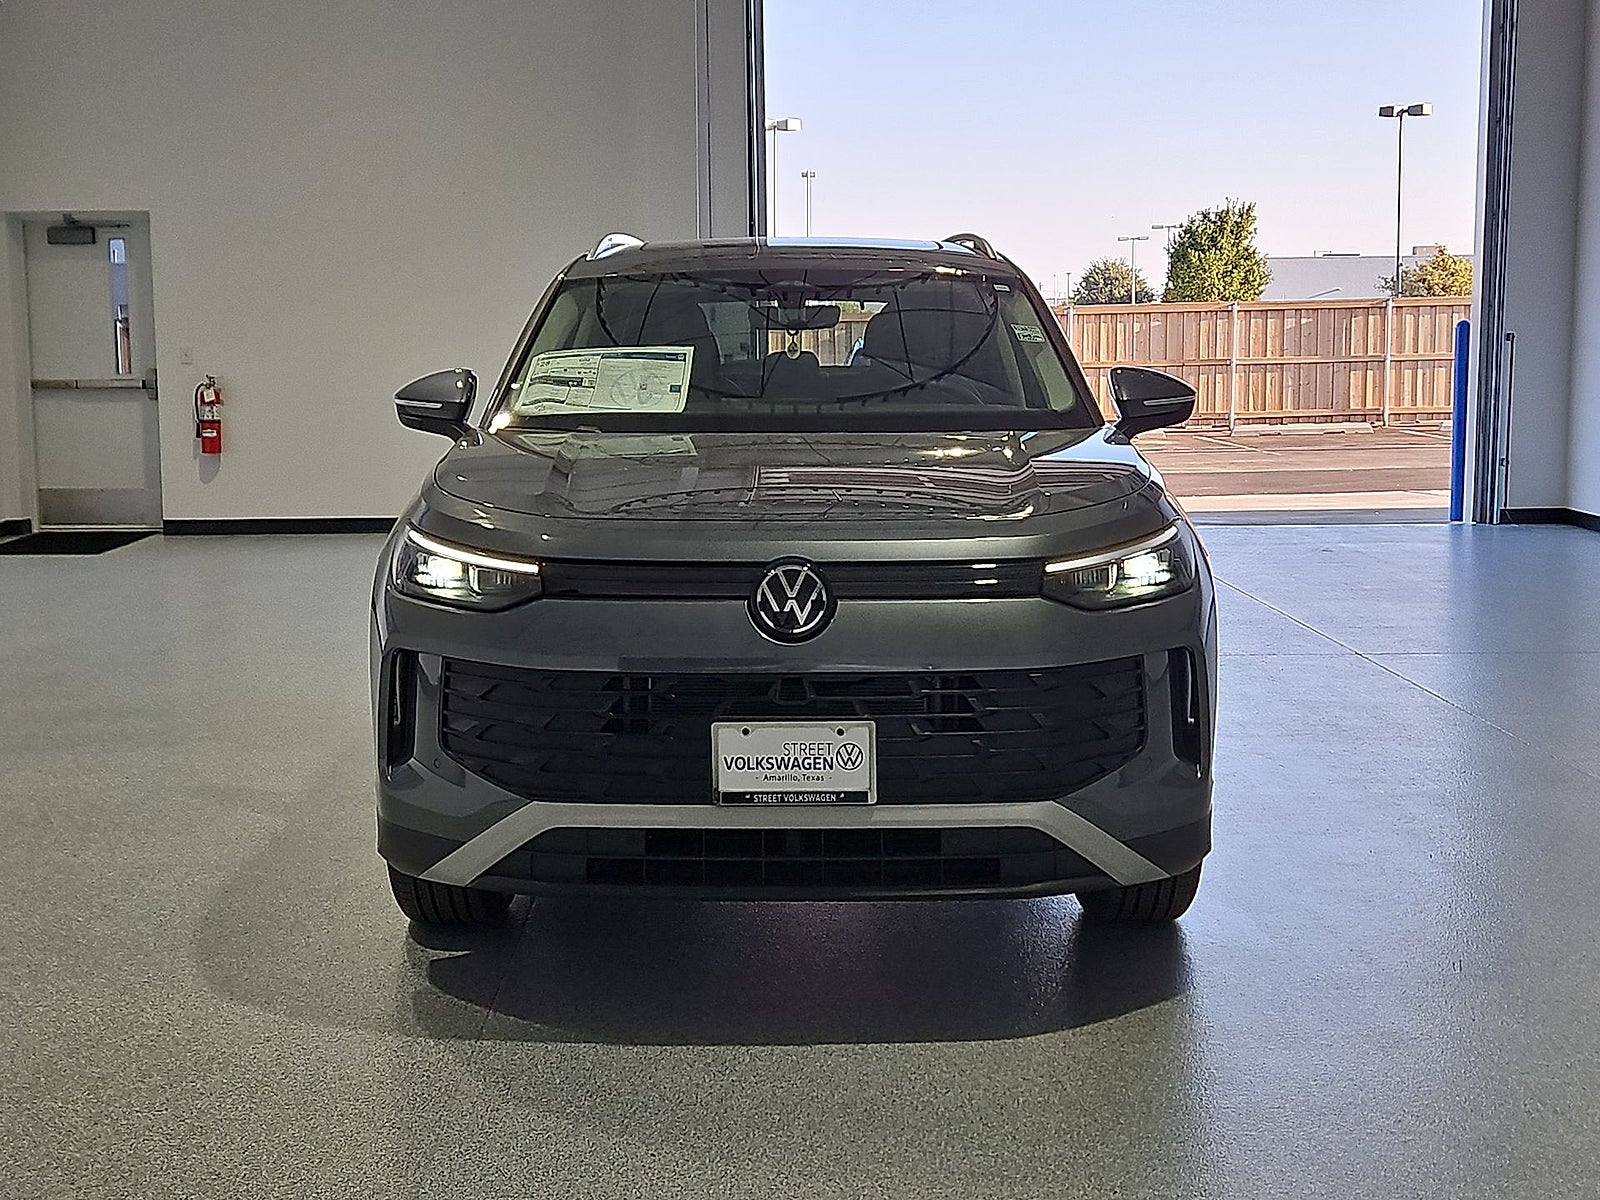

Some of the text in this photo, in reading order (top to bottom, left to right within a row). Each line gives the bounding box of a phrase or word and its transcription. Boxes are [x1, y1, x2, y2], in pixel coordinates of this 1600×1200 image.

[782, 742, 834, 756] STREET
[723, 756, 834, 771] VOLKSWAGEN
[762, 773, 825, 782] Amarillo, Texas
[753, 793, 837, 803] STREET VOLKSWAGEN
